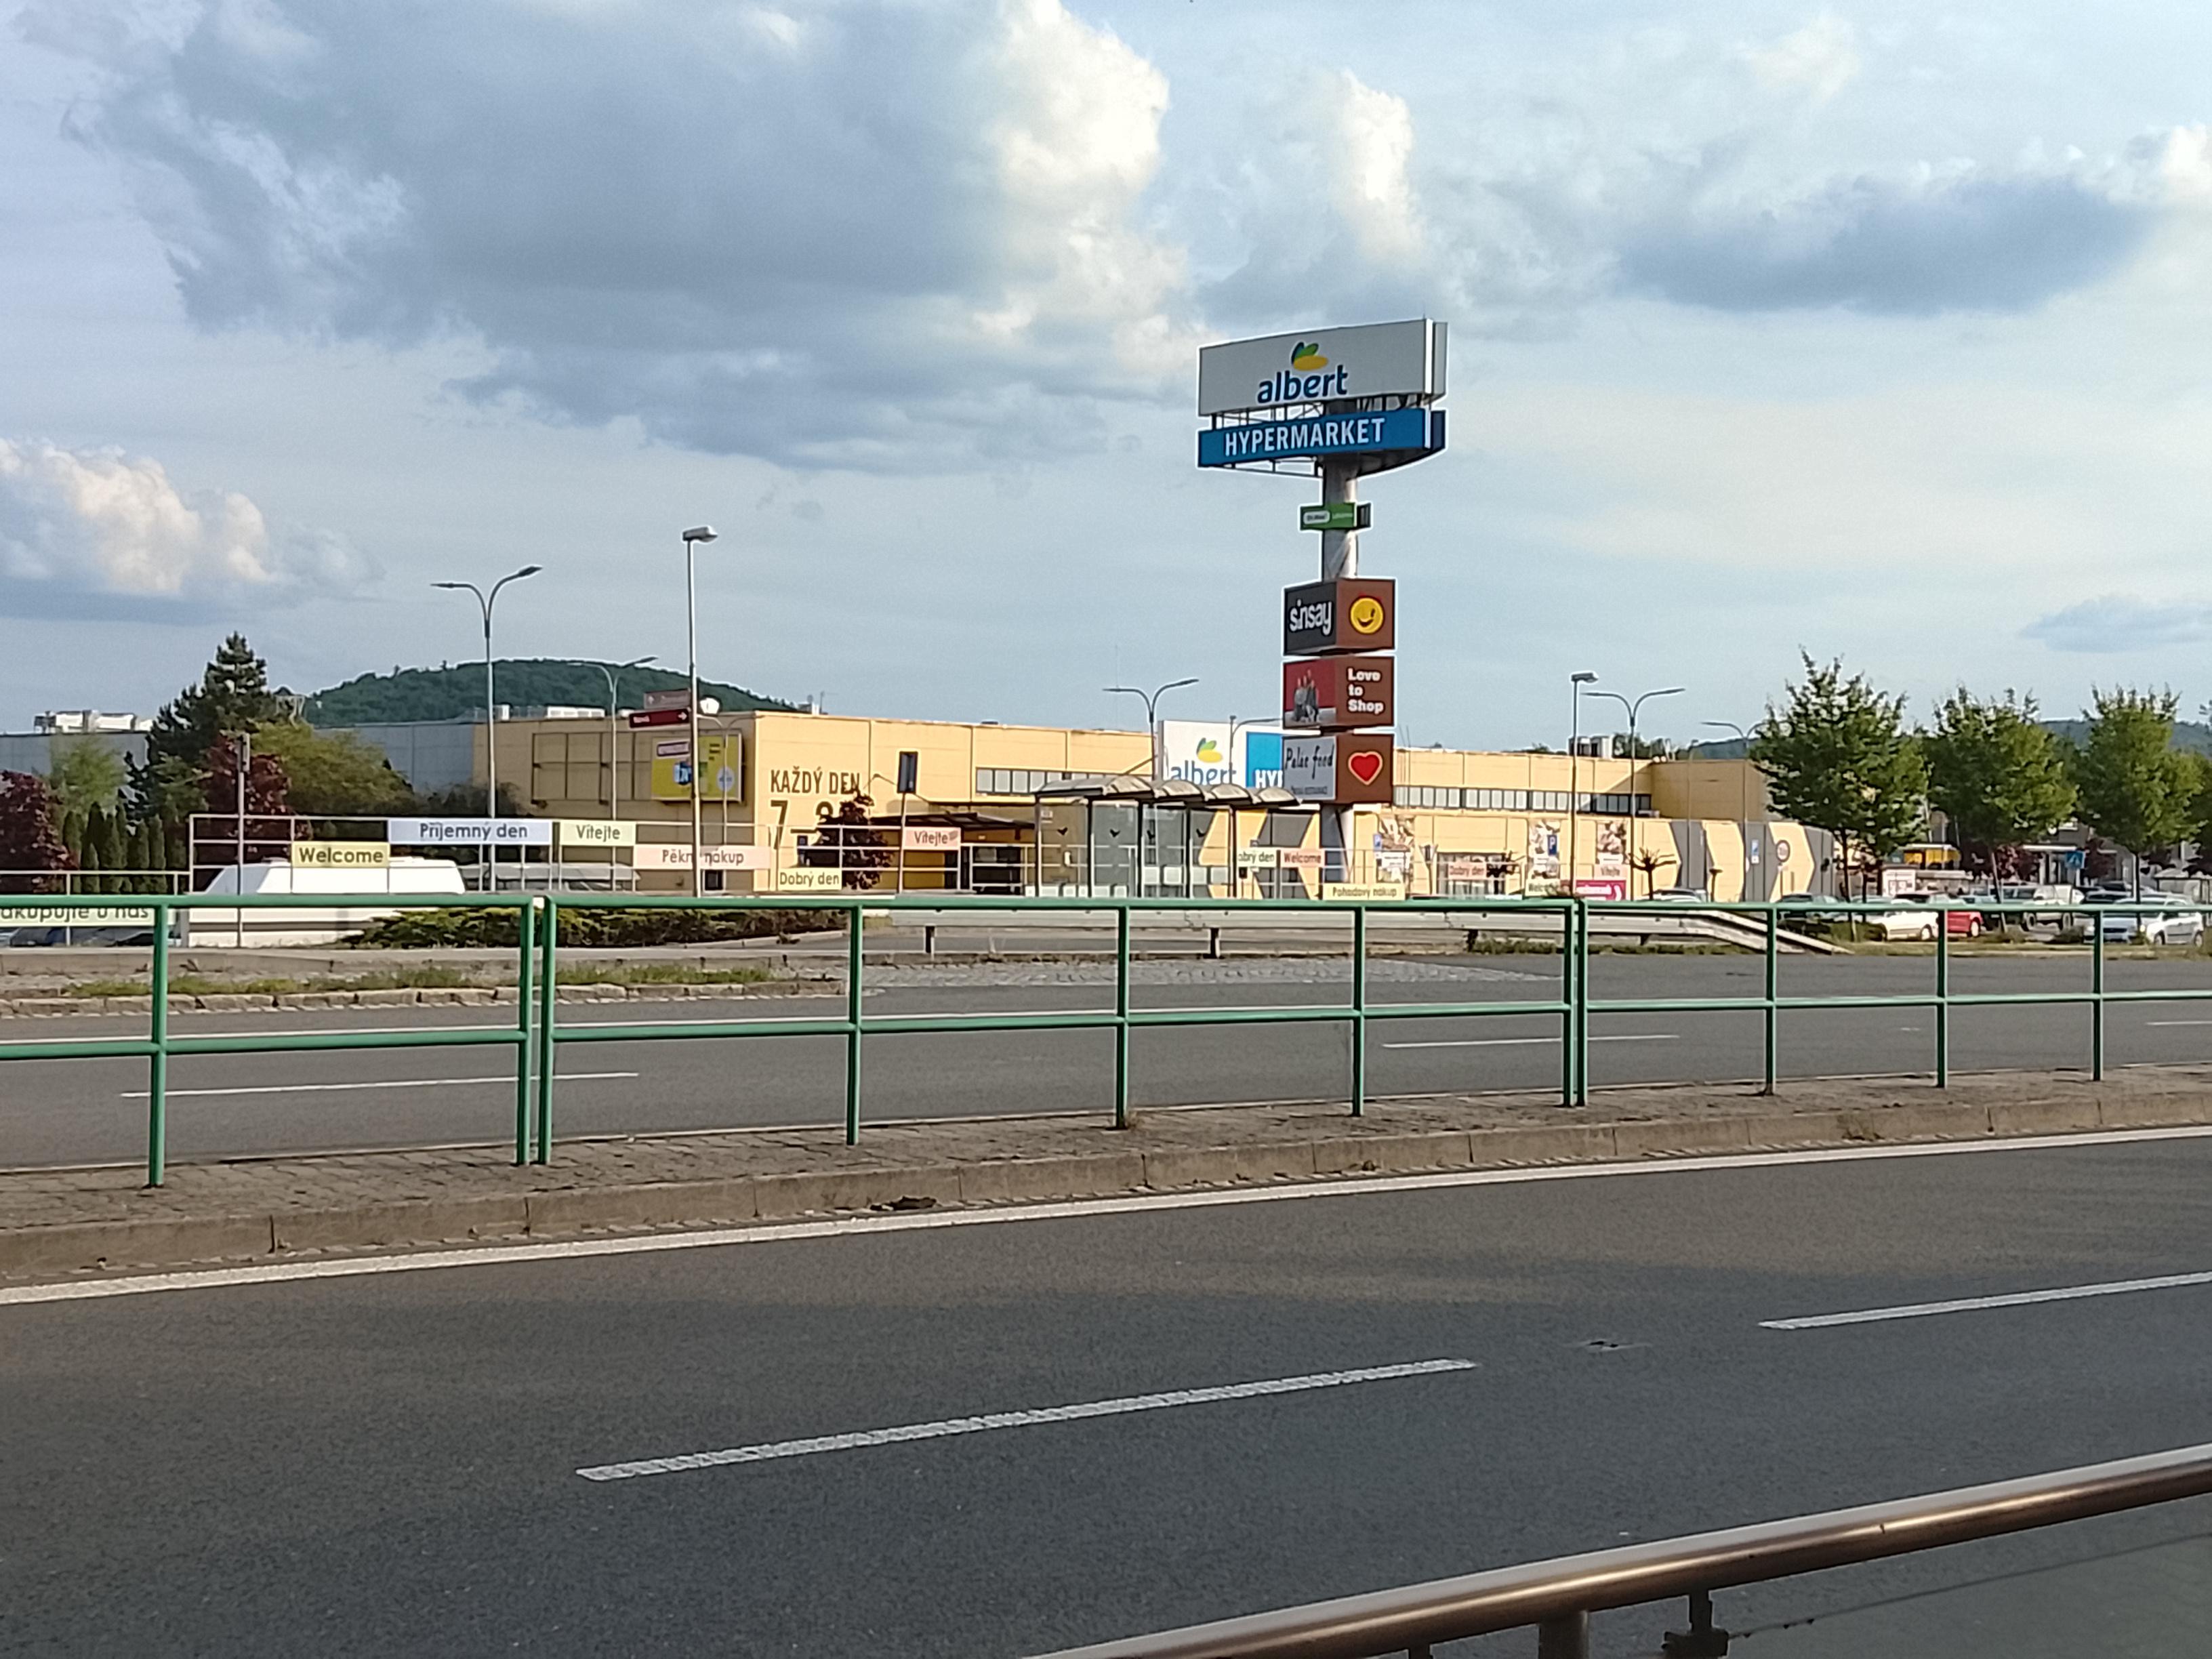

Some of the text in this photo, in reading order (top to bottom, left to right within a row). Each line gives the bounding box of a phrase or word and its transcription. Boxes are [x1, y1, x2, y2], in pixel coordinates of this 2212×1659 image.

[1257, 365, 1348, 404] albert
[1225, 417, 1385, 457] HYPERMARKET
[1290, 599, 1332, 636] sinsay
[1348, 668, 1381, 682] Love
[1348, 684, 1364, 696] to
[1348, 699, 1384, 715] Shop
[771, 765, 860, 794] KAŽDÝ DEN
[496, 823, 528, 838] den
[298, 848, 384, 863] Welcome
[662, 848, 694, 863] Pěkn
[818, 872, 840, 885] den
